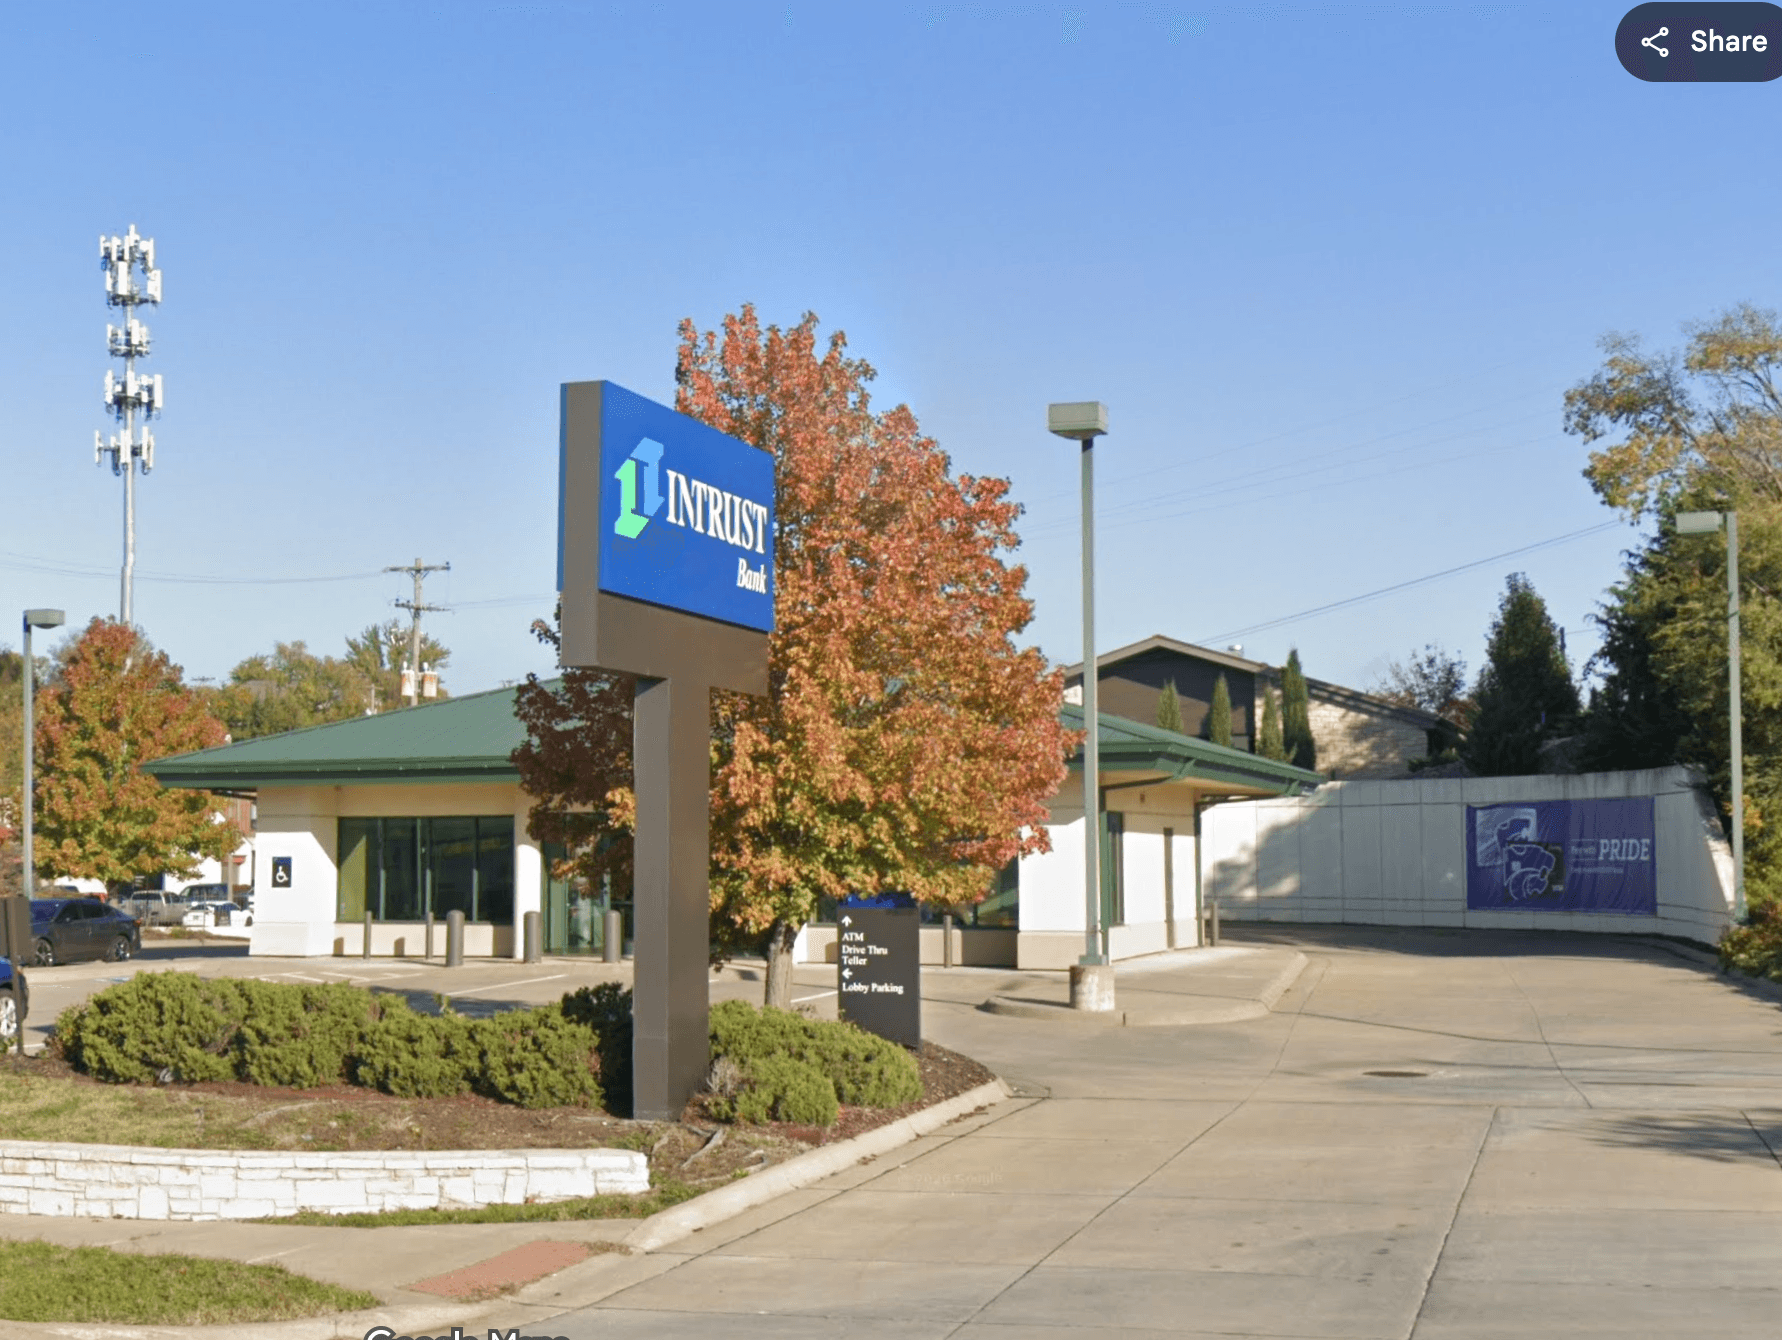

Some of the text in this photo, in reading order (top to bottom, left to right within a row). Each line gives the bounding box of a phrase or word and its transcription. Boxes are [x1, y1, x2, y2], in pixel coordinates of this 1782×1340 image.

[665, 469, 768, 555] INTRUST
[736, 557, 768, 595] Bank
[1598, 838, 1651, 861] PRIDE
[841, 932, 864, 942] ATM
[841, 944, 888, 955] Drive Thru
[841, 955, 867, 965] Teller
[842, 982, 904, 995] Lobby Parking
